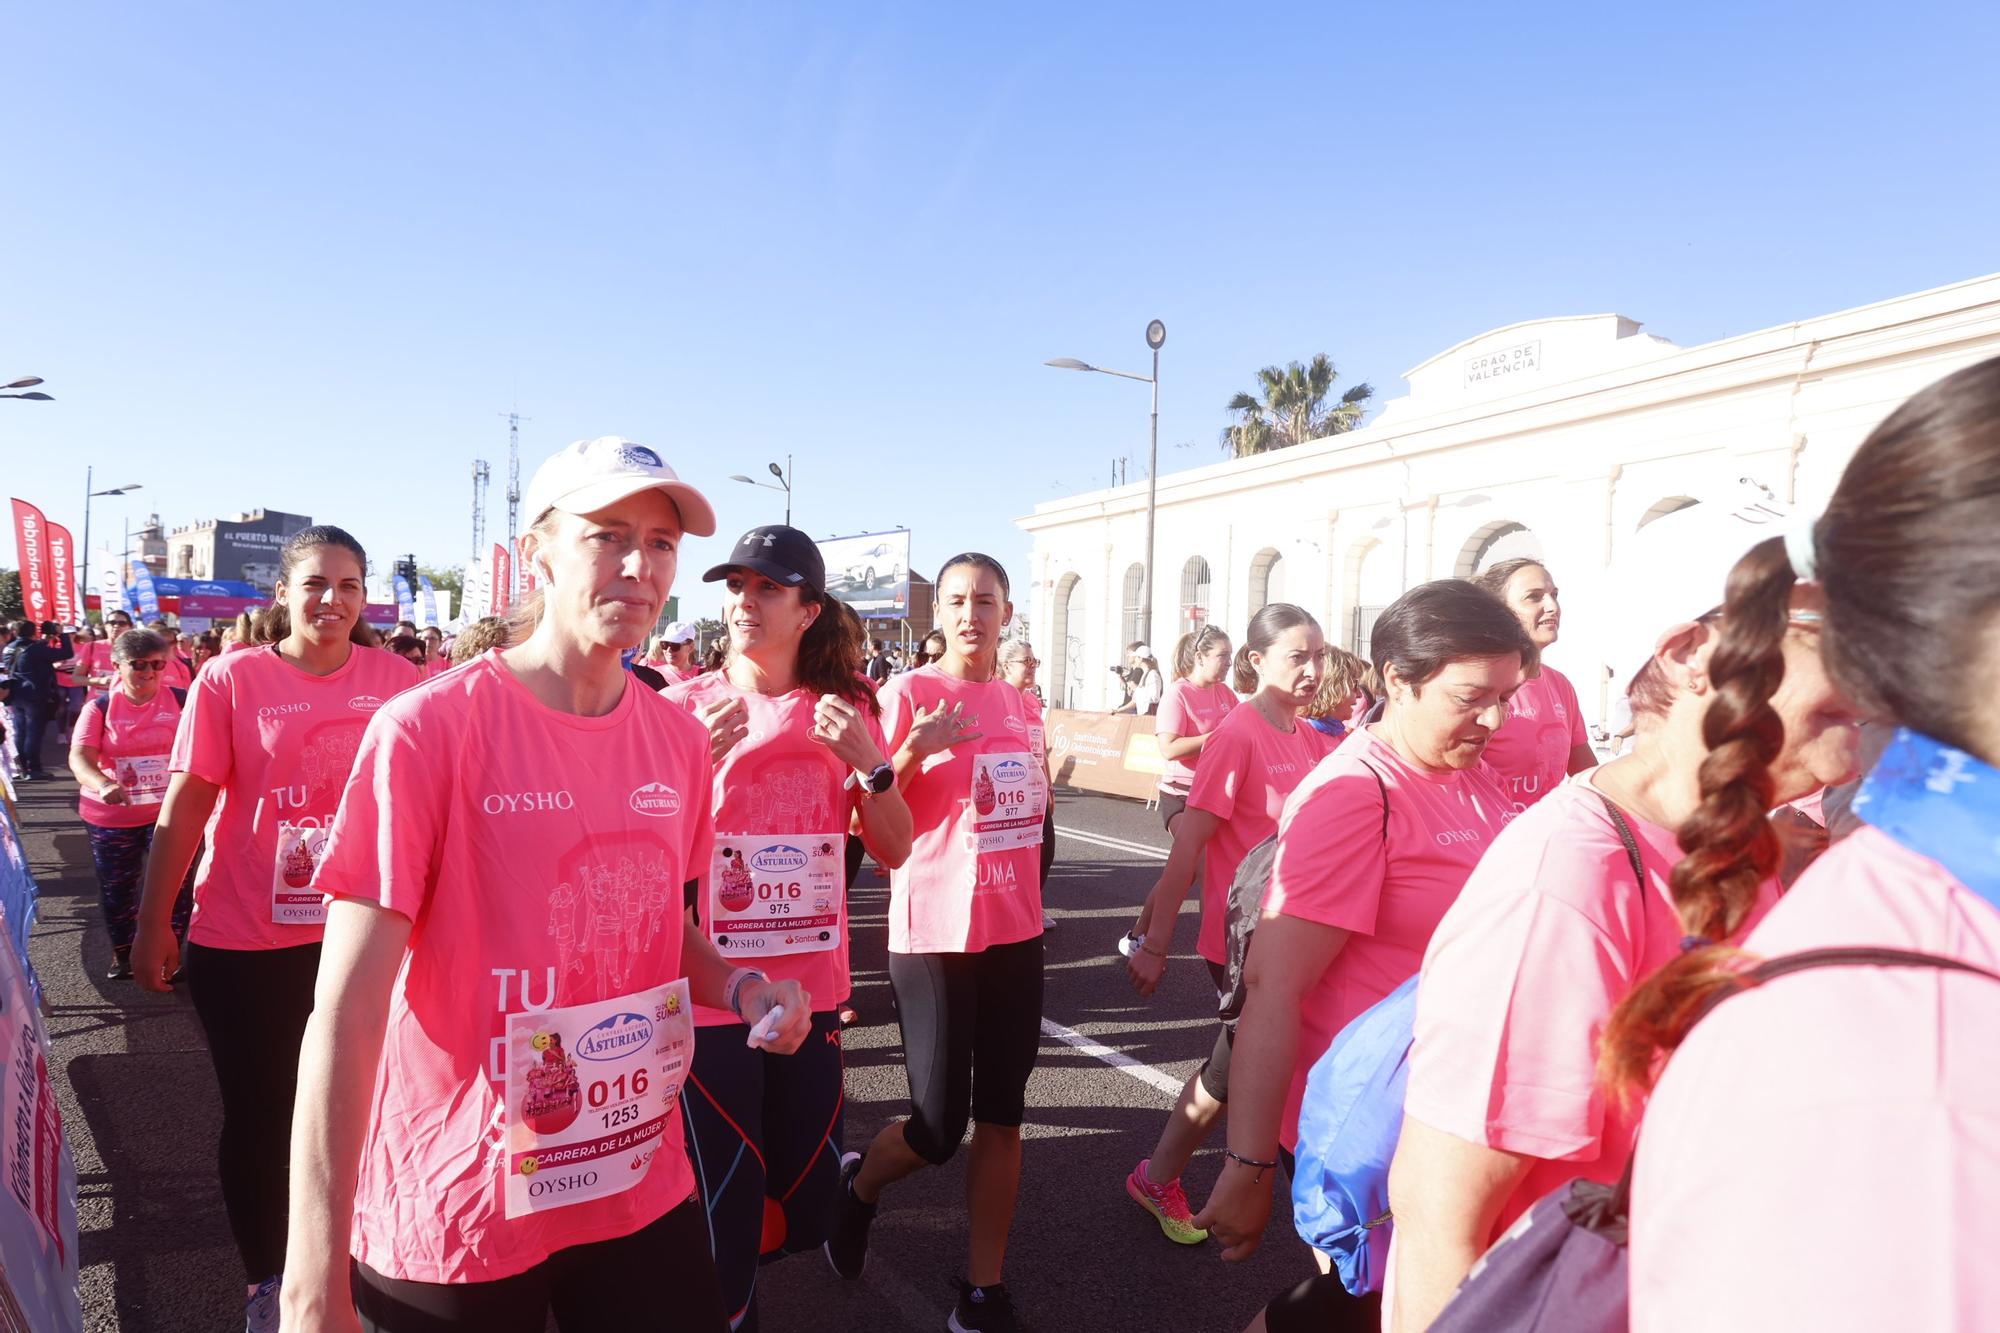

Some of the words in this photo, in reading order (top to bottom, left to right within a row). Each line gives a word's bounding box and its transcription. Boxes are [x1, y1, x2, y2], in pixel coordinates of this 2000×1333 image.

[1472, 354, 1506, 370] GRAO
[1514, 346, 1532, 359] DE
[1468, 358, 1534, 382] VALENCIA
[259, 702, 311, 717] OYSHO
[1512, 775, 1539, 793] TU
[271, 785, 307, 809] TU
[484, 790, 574, 815] OYSHO
[998, 789, 1025, 806] 016
[1005, 807, 1019, 817] 977
[979, 836, 1005, 847] OYSHO
[755, 855, 804, 867] ASTURIANA
[757, 882, 802, 900] 016
[283, 909, 321, 917] OYSHO
[769, 903, 790, 915] 975
[727, 922, 764, 930] CARRERA
[765, 921, 777, 929] DE
[777, 921, 787, 929] LA
[788, 919, 812, 928] MUJER
[813, 917, 829, 925] 2023
[723, 938, 765, 949] OYSHO
[491, 966, 556, 1012] TU
[656, 1006, 681, 1022] SUMA
[583, 1028, 649, 1055] ASTURIANA
[587, 1067, 649, 1108] 016
[601, 1104, 639, 1129] 1253
[536, 1144, 597, 1165] CARRERA
[599, 1140, 616, 1152] DE
[618, 1132, 632, 1146] LA
[633, 1121, 661, 1142] MUJER
[10, 1107, 32, 1212] Kilómetro
[529, 1171, 598, 1197] OYSHO
